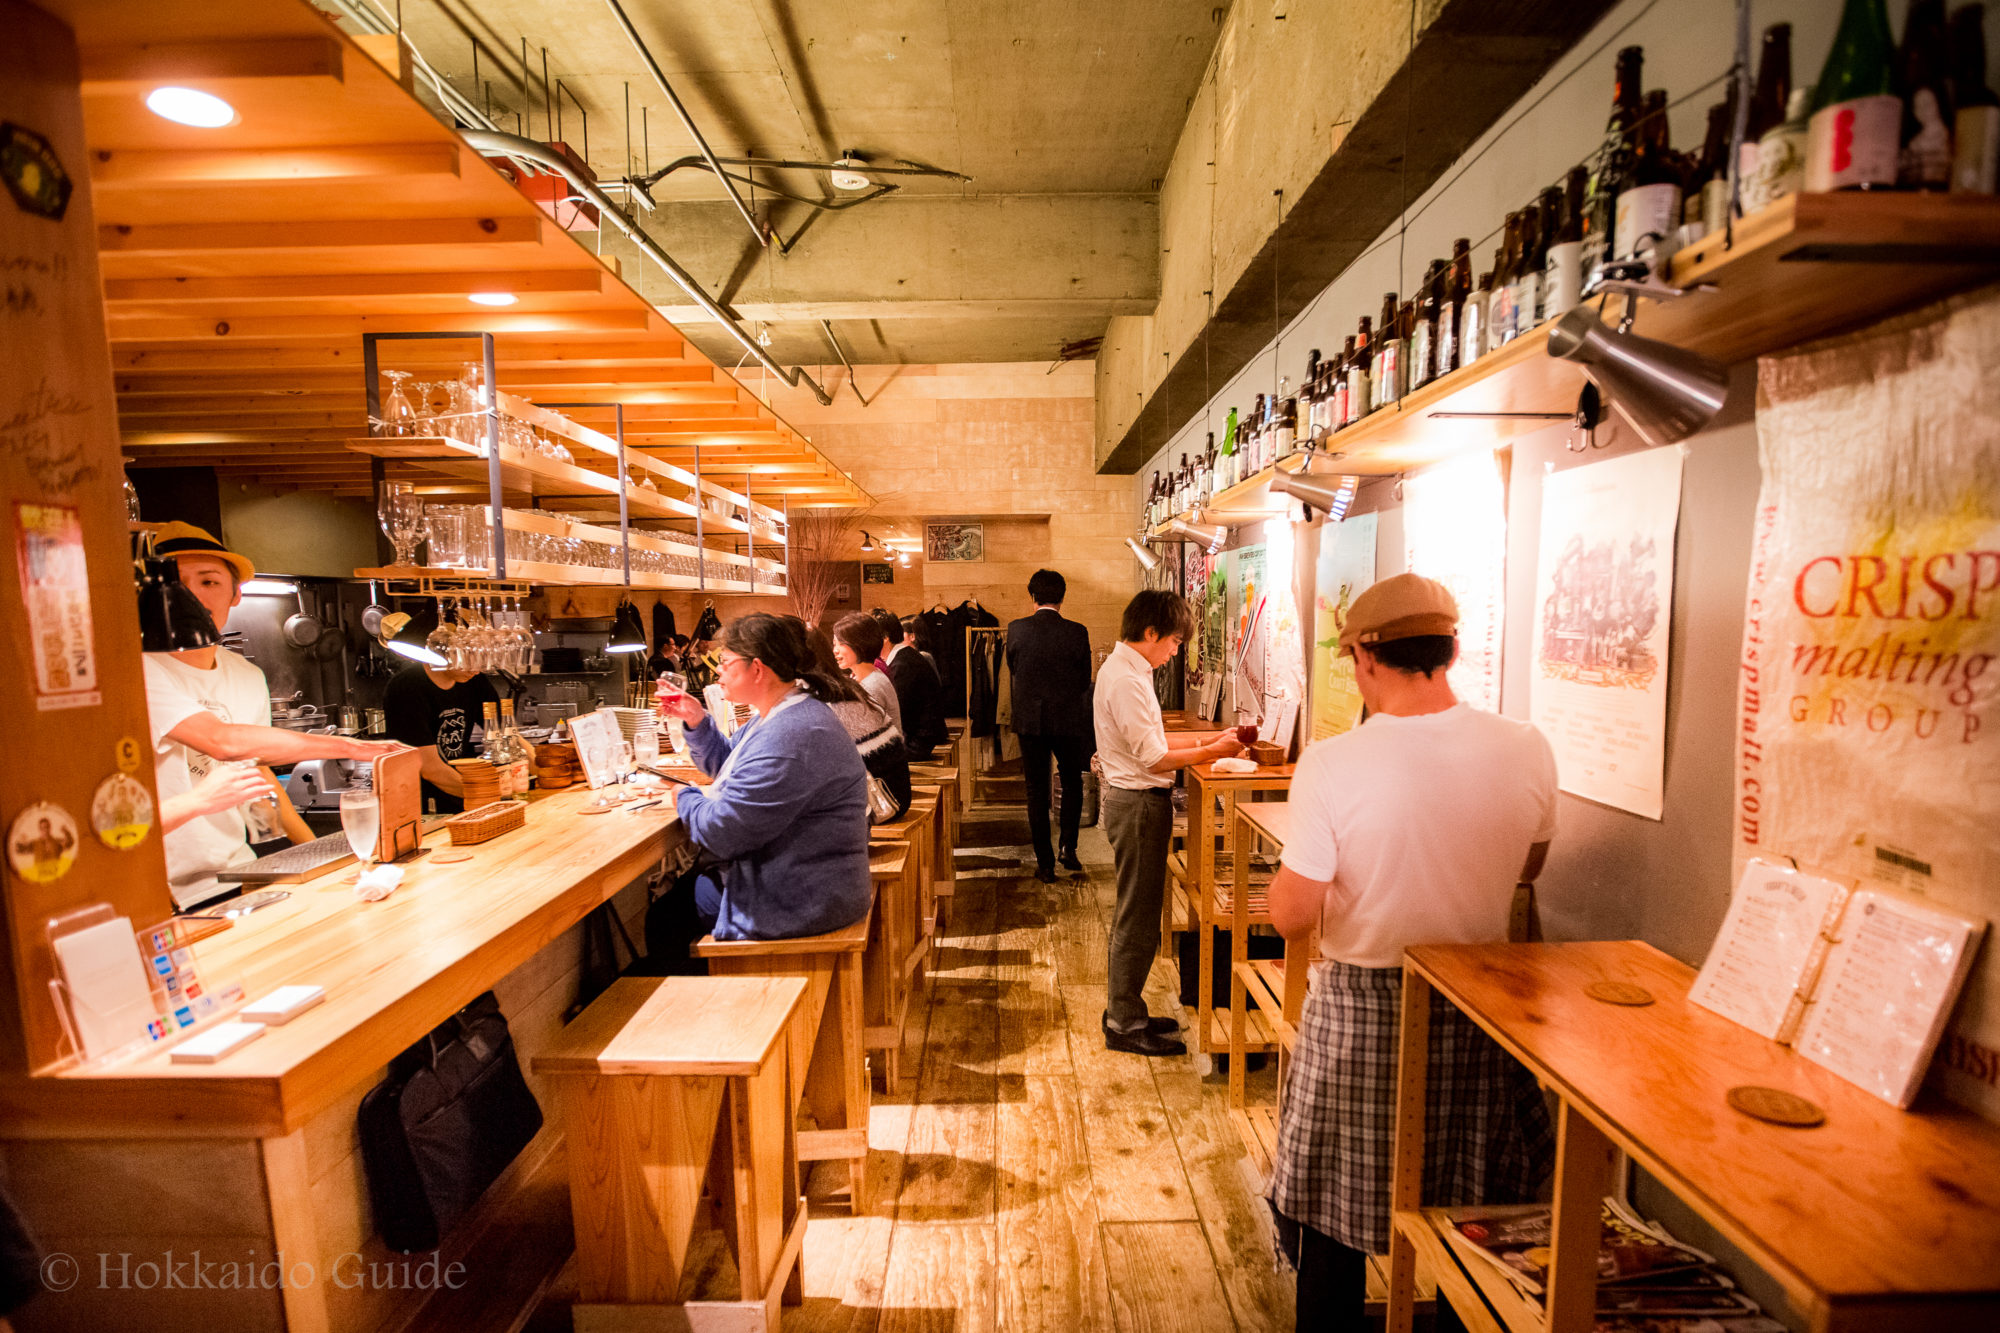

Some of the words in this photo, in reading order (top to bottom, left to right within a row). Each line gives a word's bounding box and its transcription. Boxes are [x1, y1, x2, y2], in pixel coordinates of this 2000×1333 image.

[1793, 551, 2000, 623] CRISP
[1792, 632, 1996, 706] malting
[1789, 695, 1981, 744] GROUP
